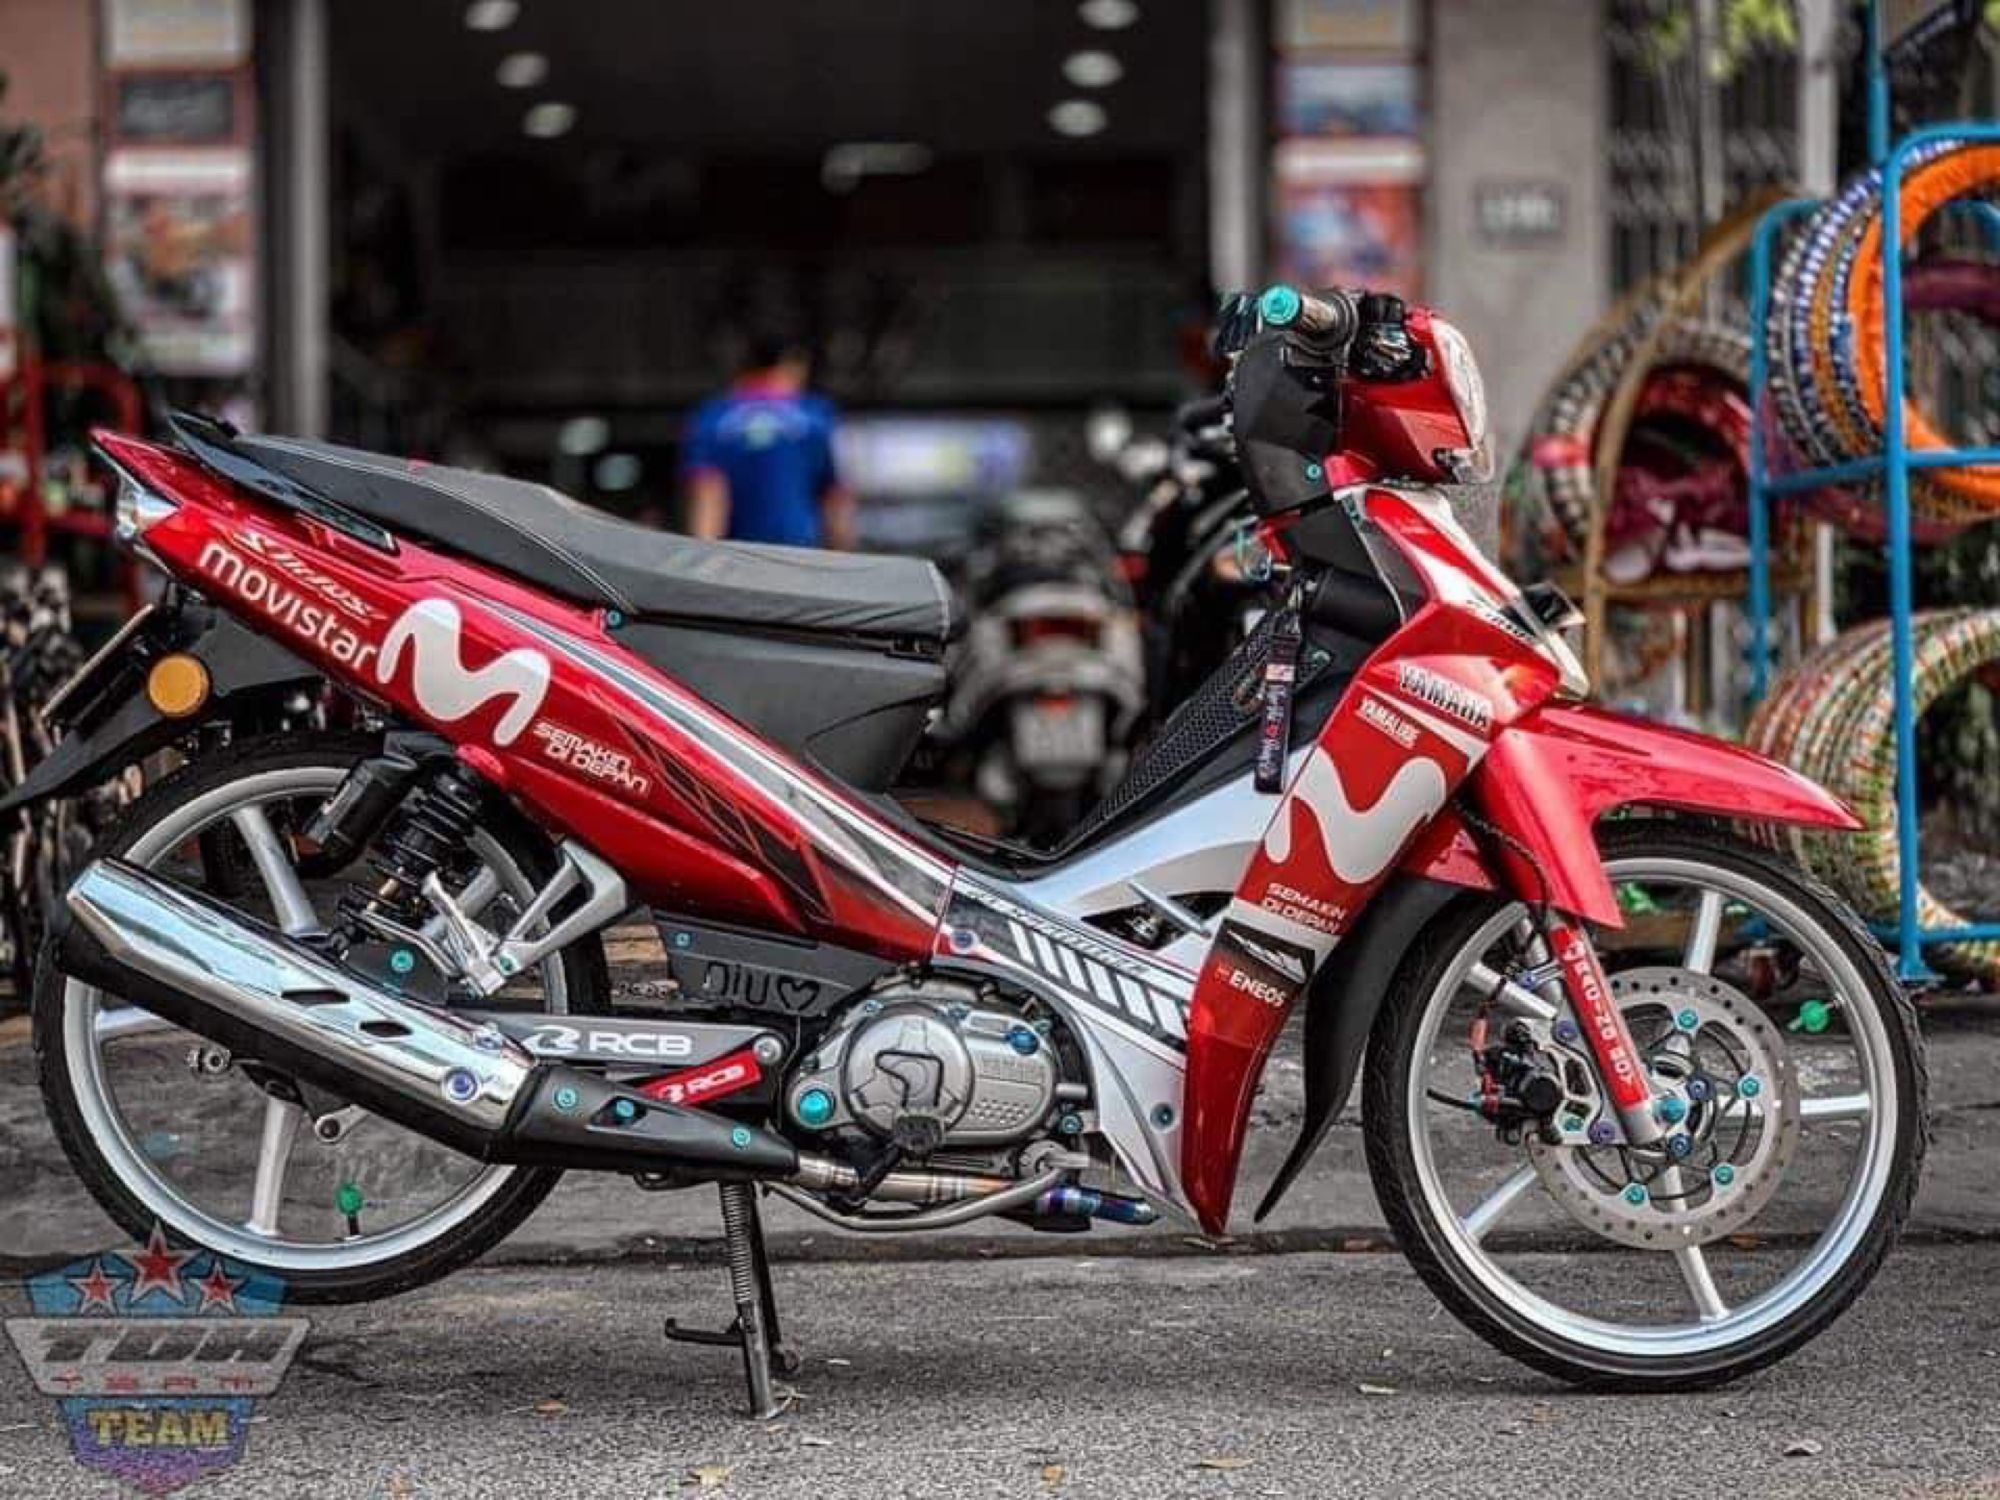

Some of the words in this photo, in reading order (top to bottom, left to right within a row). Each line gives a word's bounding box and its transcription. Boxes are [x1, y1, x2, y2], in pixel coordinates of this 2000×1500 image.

[197, 541, 378, 668] movistar
[1400, 665, 1489, 734] YAMAHA
[1229, 969, 1287, 1008] ENEOS
[589, 1033, 692, 1056] RCB
[688, 1065, 745, 1095] RCB
